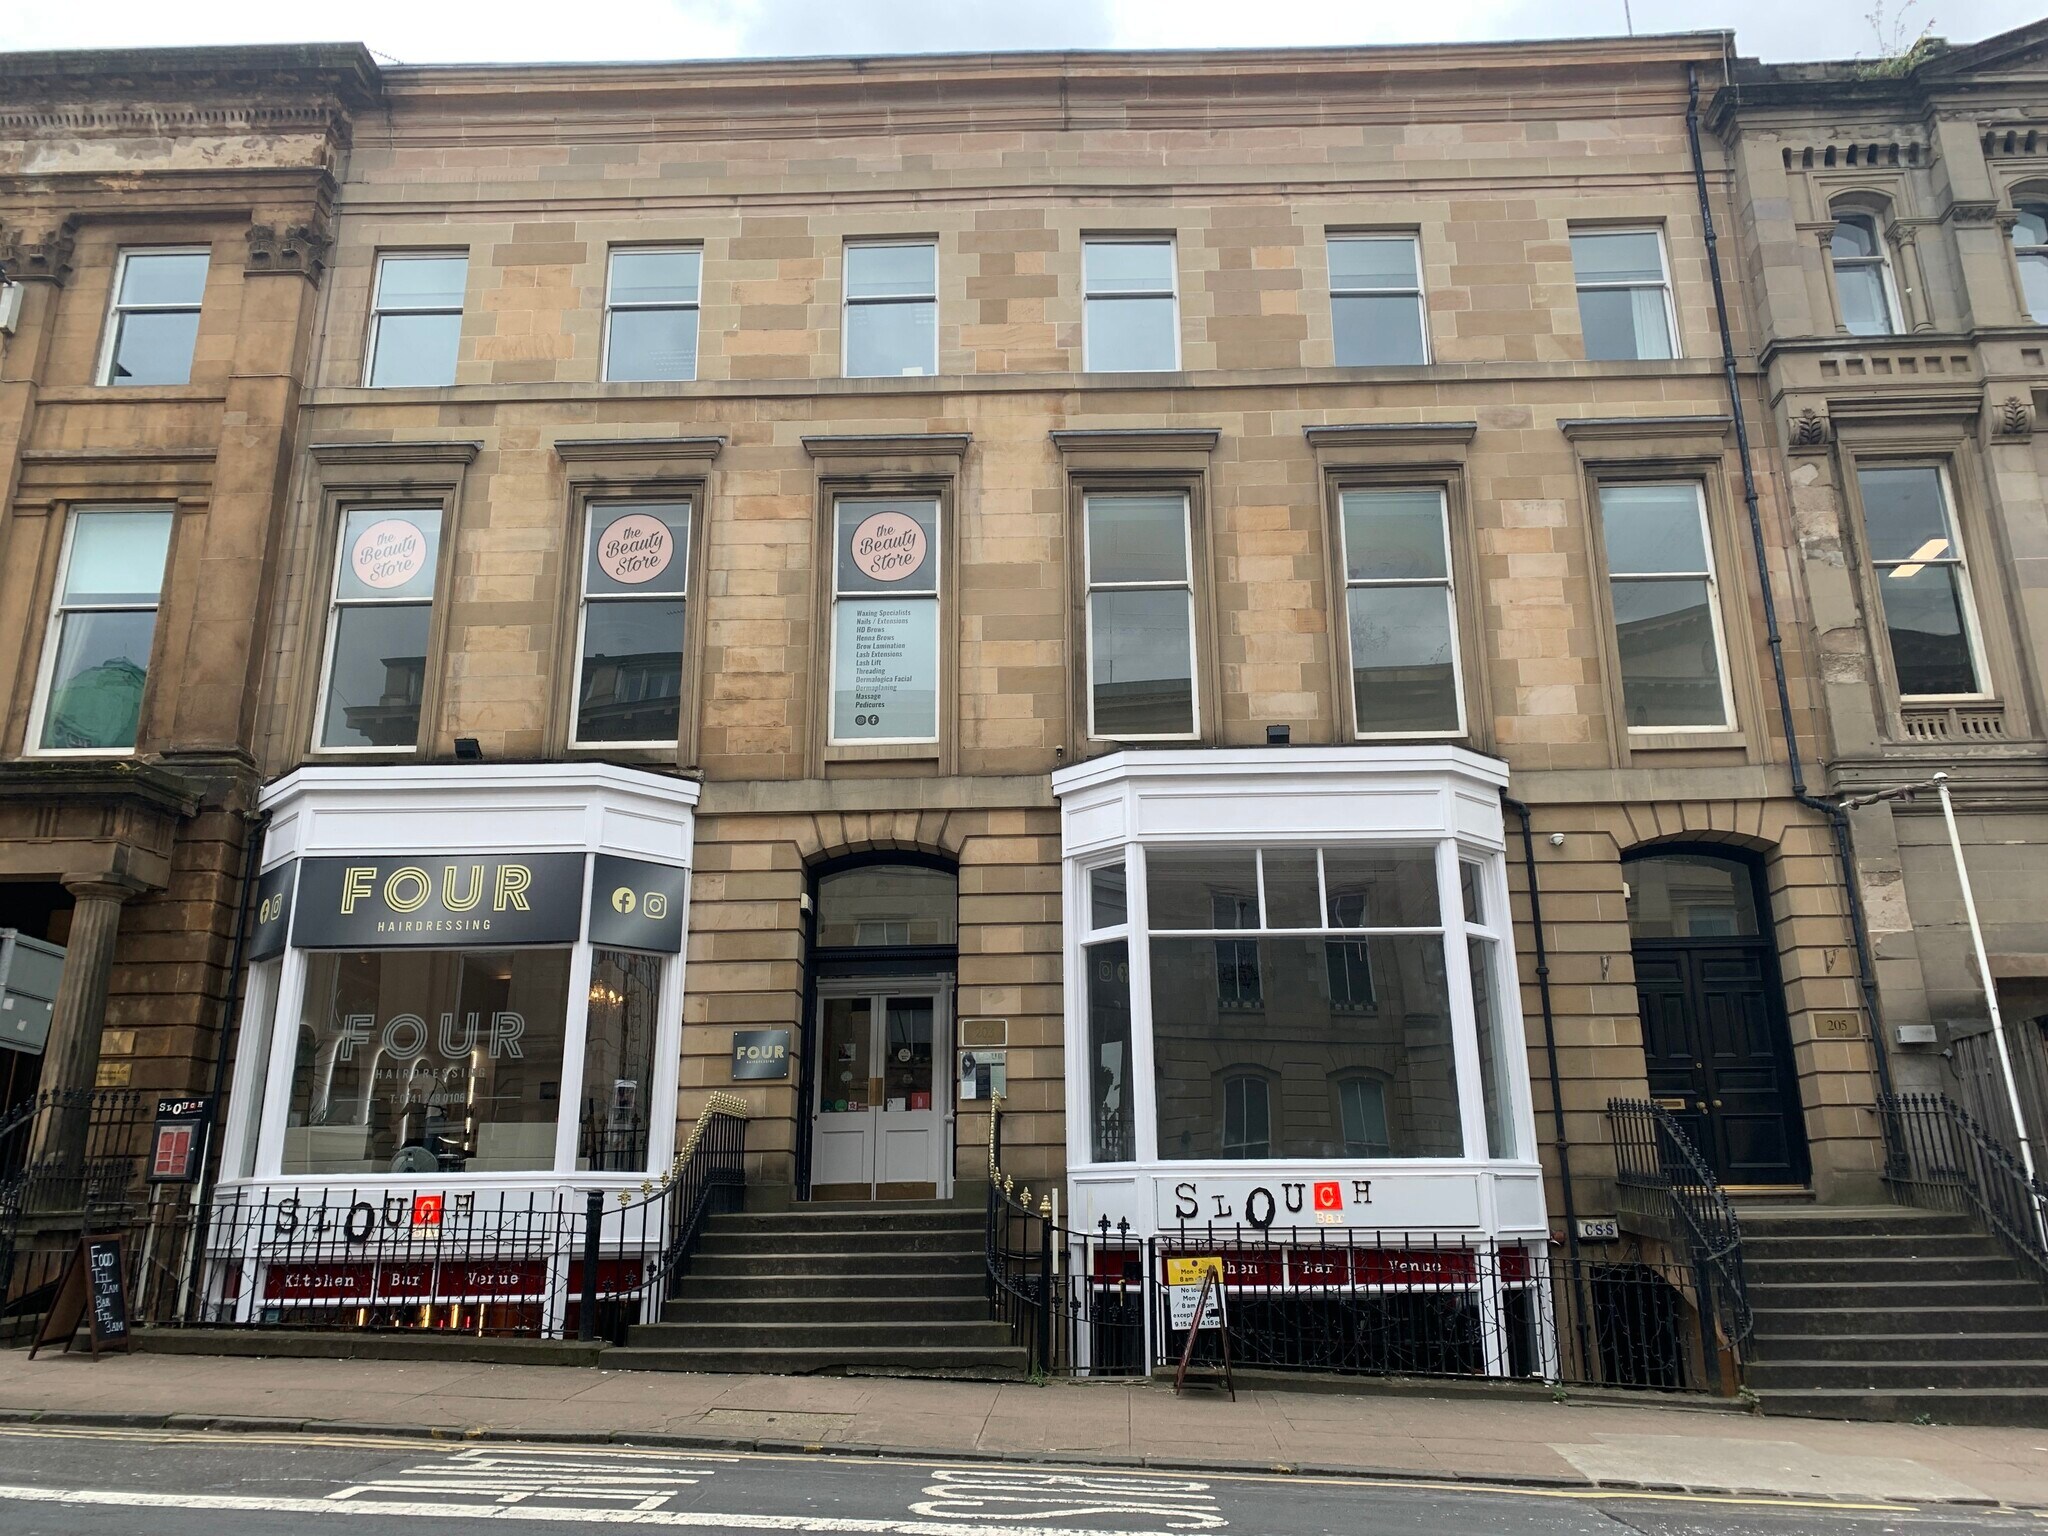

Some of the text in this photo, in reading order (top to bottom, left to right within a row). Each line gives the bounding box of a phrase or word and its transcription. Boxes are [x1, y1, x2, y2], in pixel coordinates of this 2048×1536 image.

[623, 526, 642, 540] the
[876, 524, 895, 538] the
[376, 532, 395, 546] the
[605, 531, 664, 559] Beauty
[859, 529, 917, 556] Beauty
[359, 534, 417, 565] Beauty
[369, 559, 414, 582] Store
[615, 555, 661, 576] Store
[870, 553, 915, 573] Store
[879, 609, 911, 617] Specialists
[340, 864, 532, 914] FOUR
[377, 919, 491, 932] HAIRDRESSING
[1826, 1019, 1848, 1031] 205
[340, 1011, 525, 1062] FOUR
[736, 1045, 785, 1060] FOUR
[400, 1093, 421, 1104] 041
[158, 1100, 204, 1115] SLOUCH
[1175, 1180, 1372, 1229] SLOUCH
[275, 1195, 472, 1243] SLOUCH
[1315, 1211, 1345, 1224] Bar
[90, 1245, 114, 1268] FOOD
[1303, 1260, 1442, 1274] Bar Venue
[285, 1272, 519, 1287] Kitchen Bar Venue
[95, 1295, 111, 1309] BAR
[907, 1469, 1230, 1529] BUS
